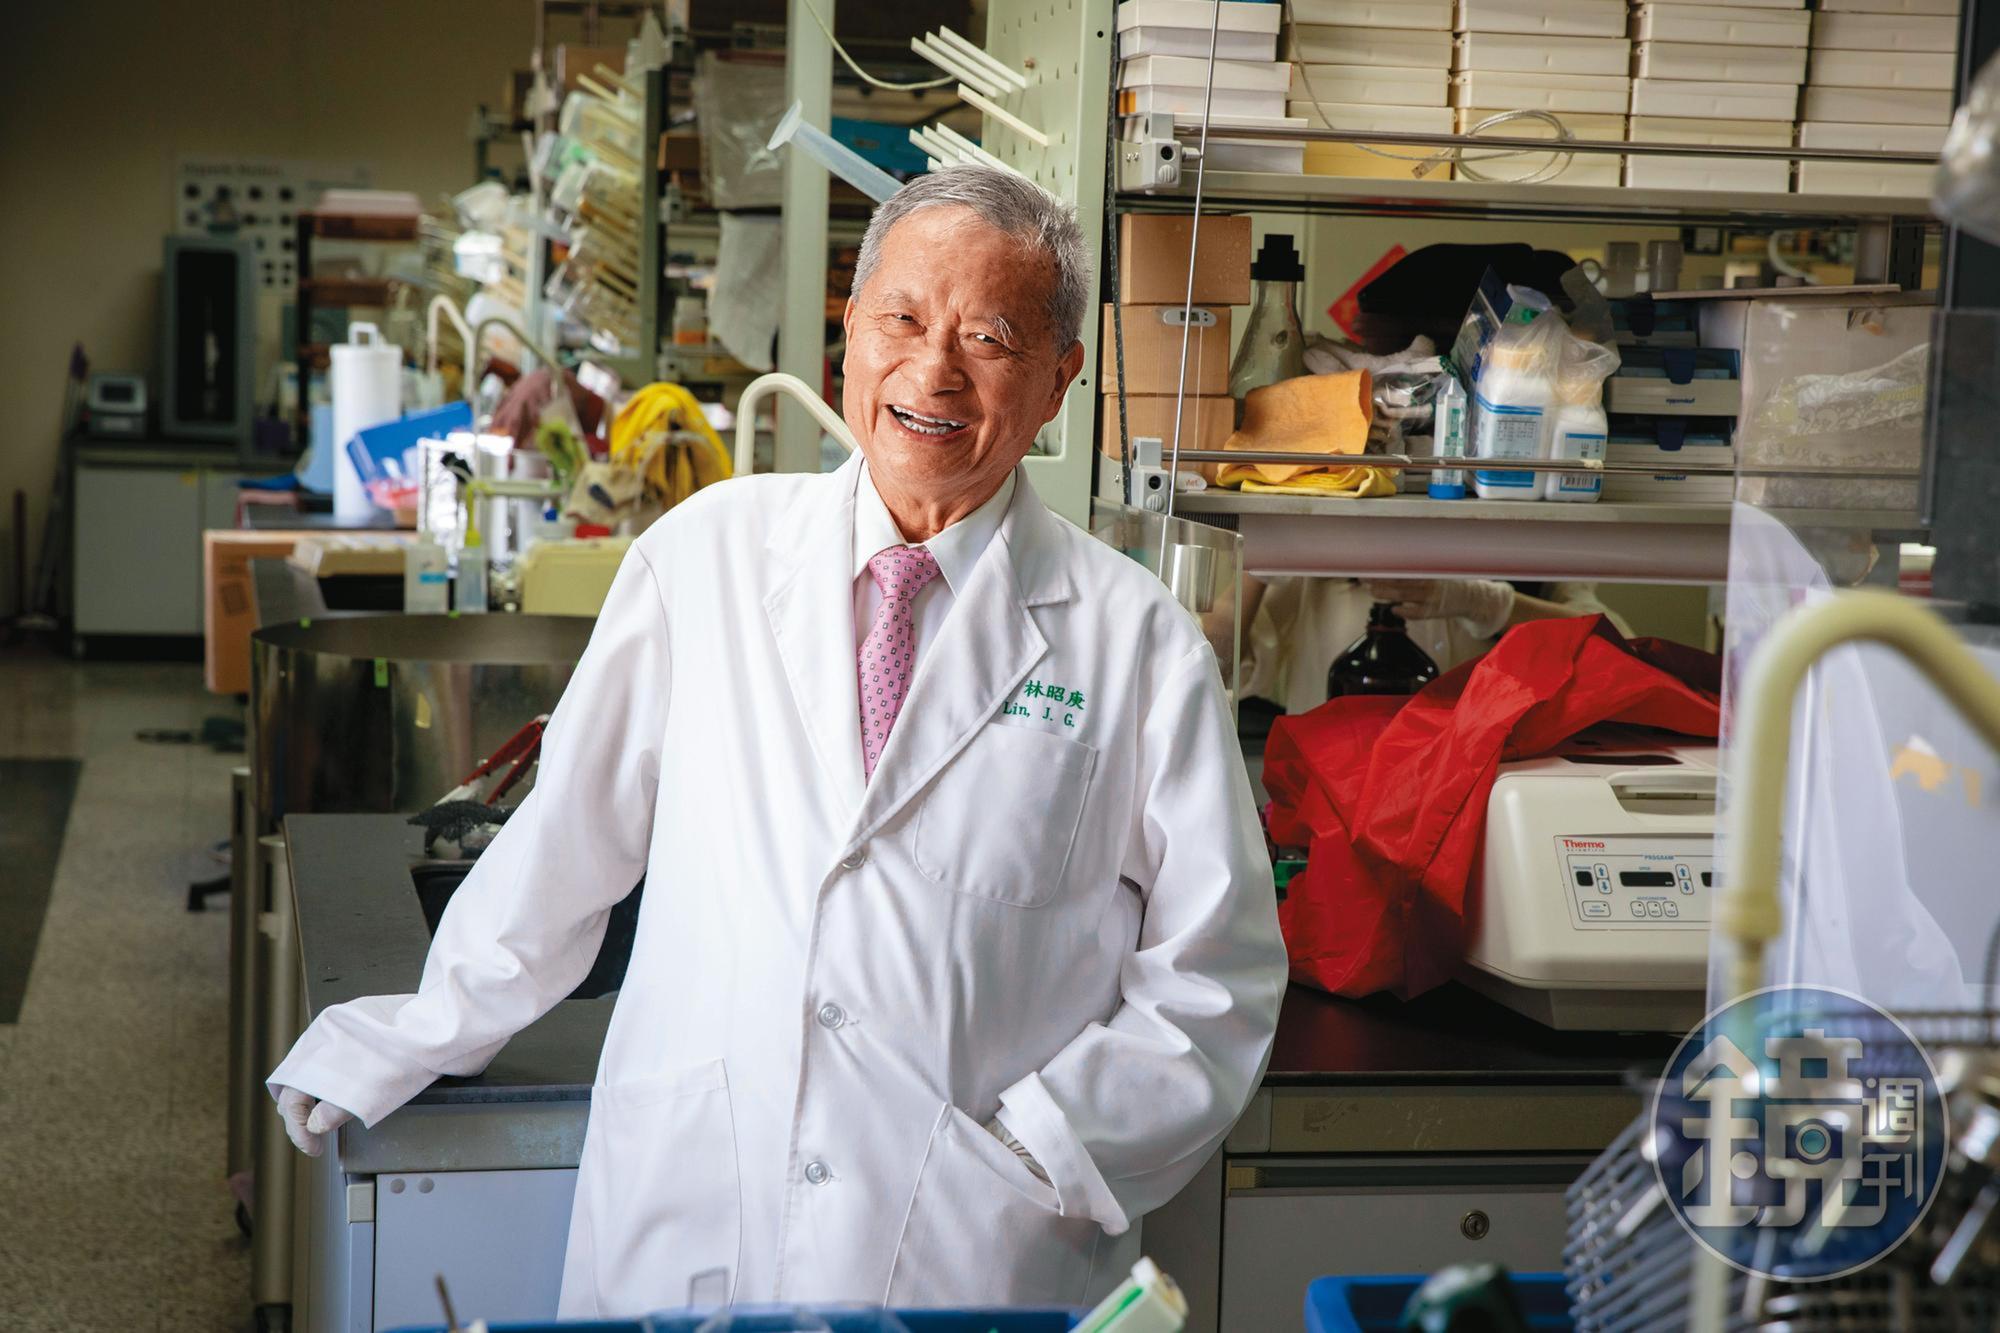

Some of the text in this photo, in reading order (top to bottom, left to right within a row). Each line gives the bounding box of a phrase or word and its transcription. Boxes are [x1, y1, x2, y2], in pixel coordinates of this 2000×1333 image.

[1023, 679, 1086, 710] 林昭庚
[1002, 701, 1076, 728] Lin, J. G.
[1562, 839, 1605, 849] Thermo
